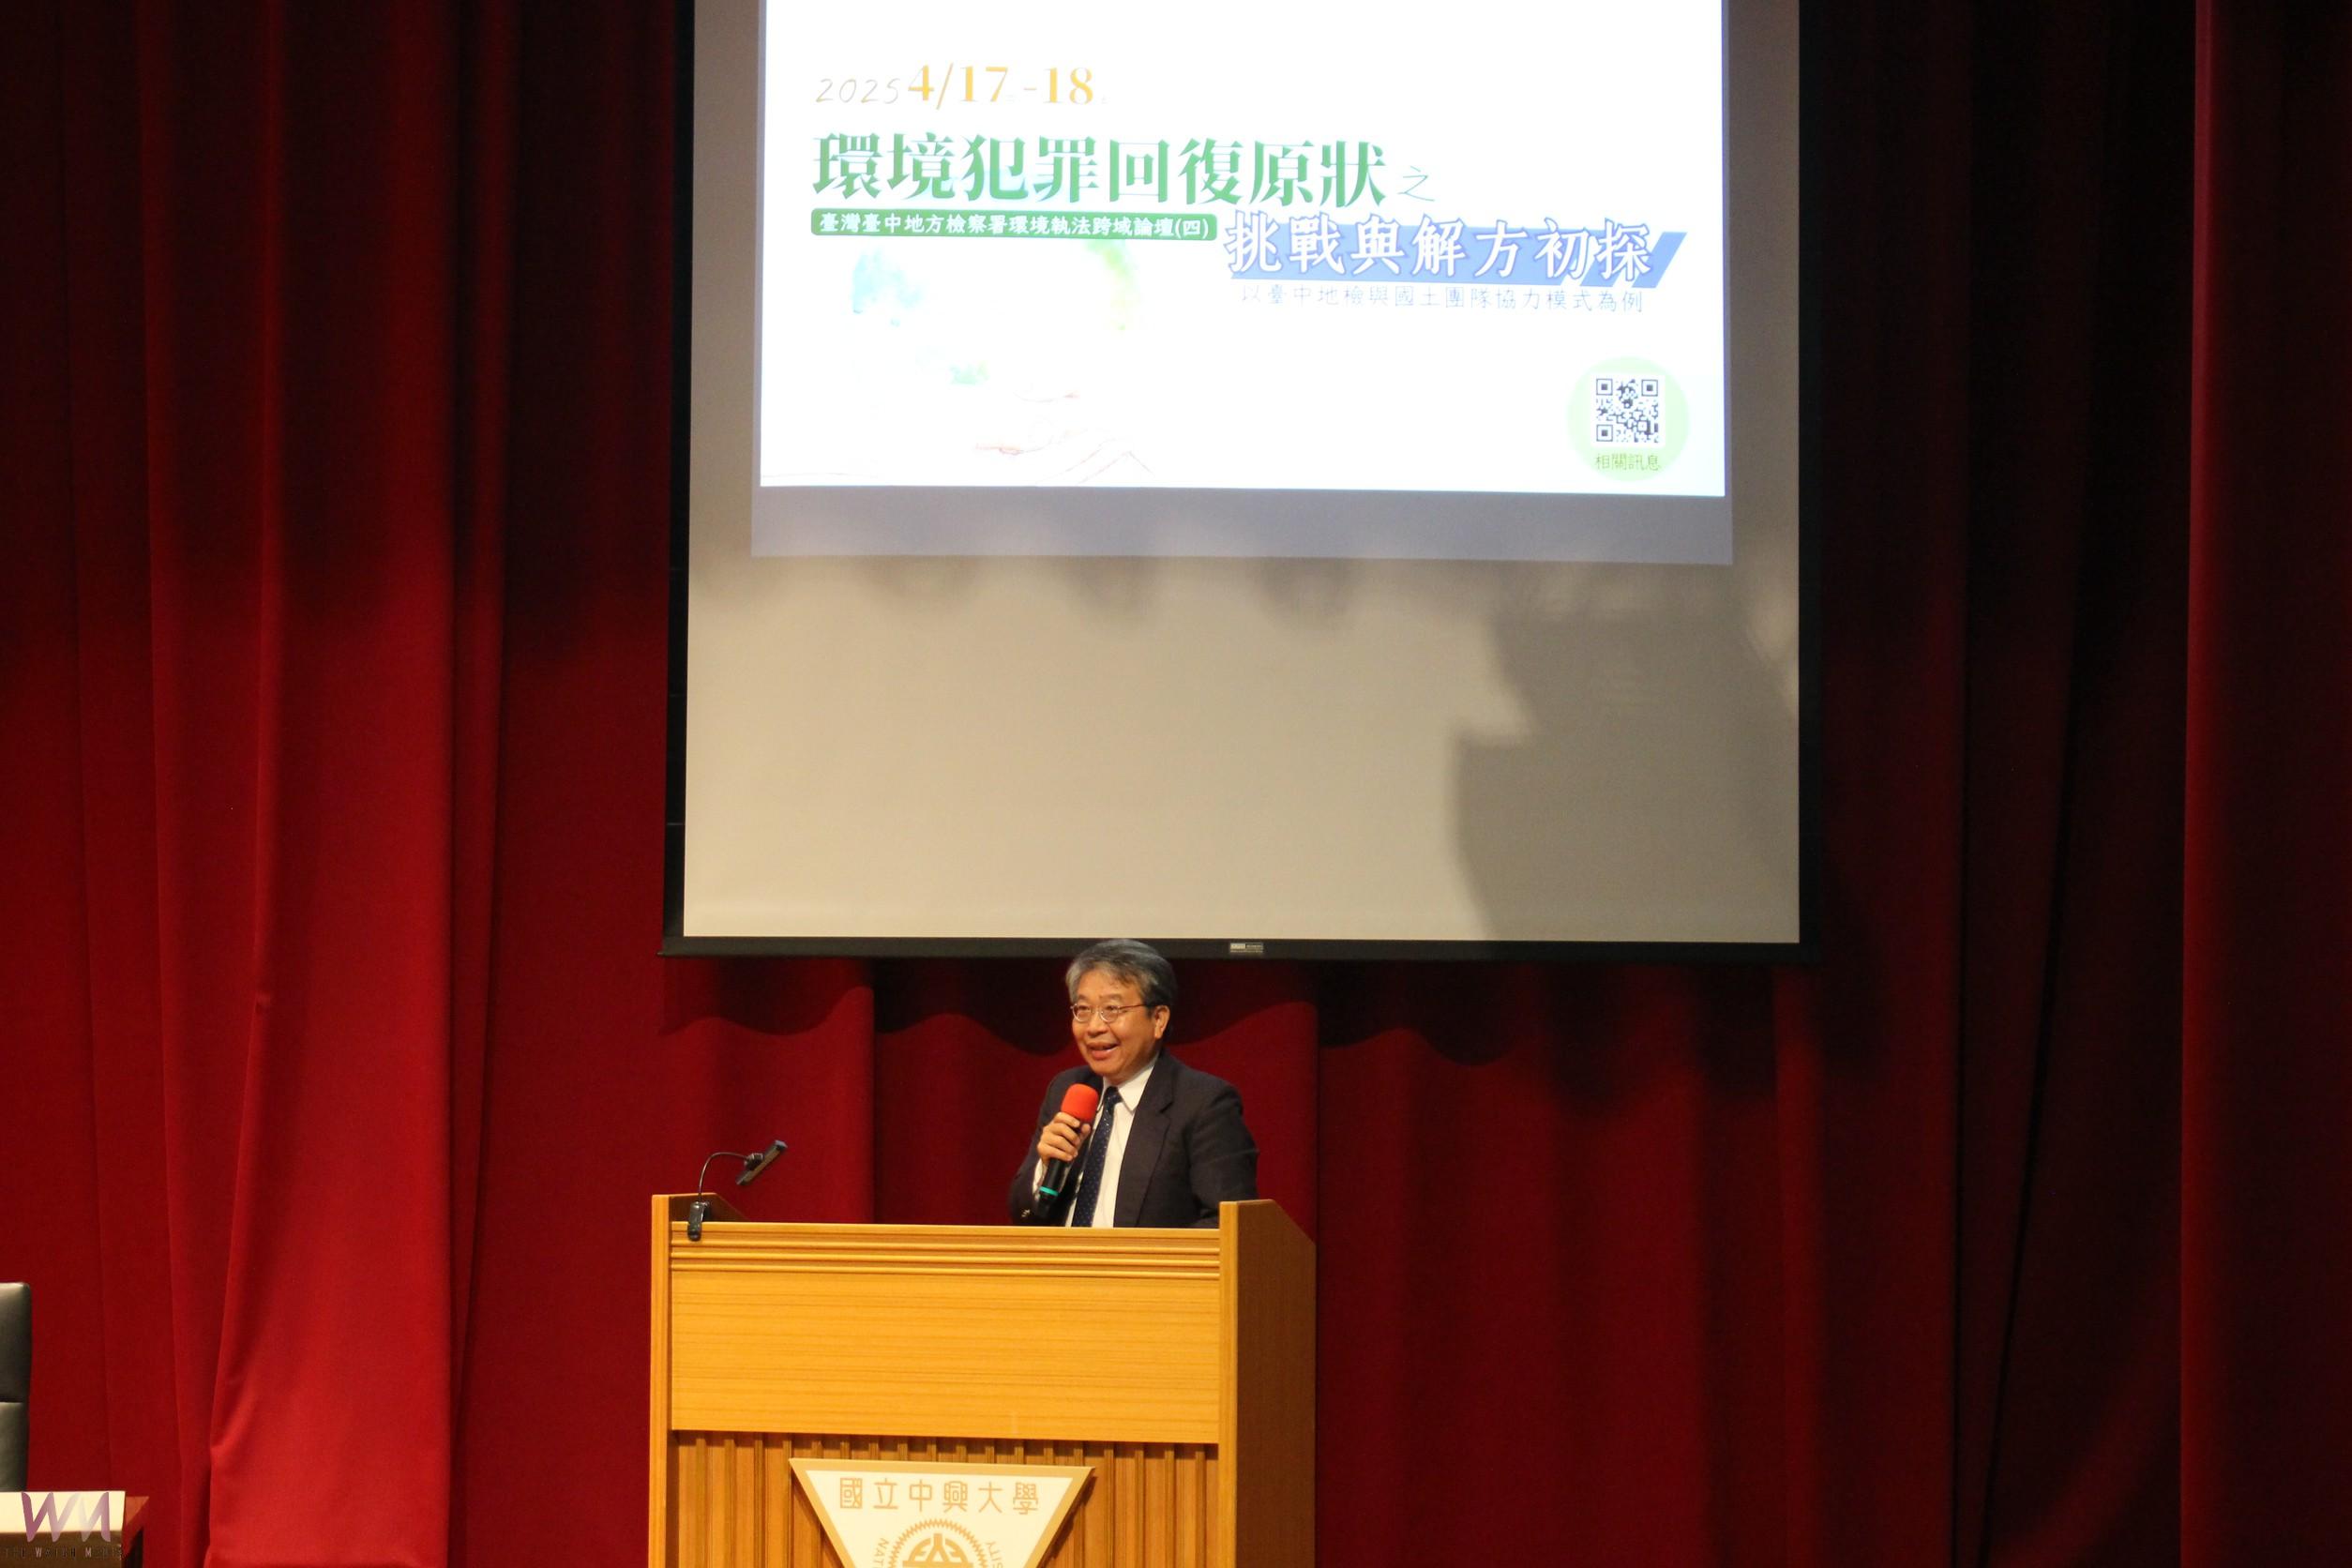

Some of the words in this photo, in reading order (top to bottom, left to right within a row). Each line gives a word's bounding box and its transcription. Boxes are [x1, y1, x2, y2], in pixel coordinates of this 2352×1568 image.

[1223, 209, 1654, 282] 挑戰與解方初探
[1595, 453, 1662, 471] 相關訊息
[839, 1477, 1038, 1515] 國立中興大學
